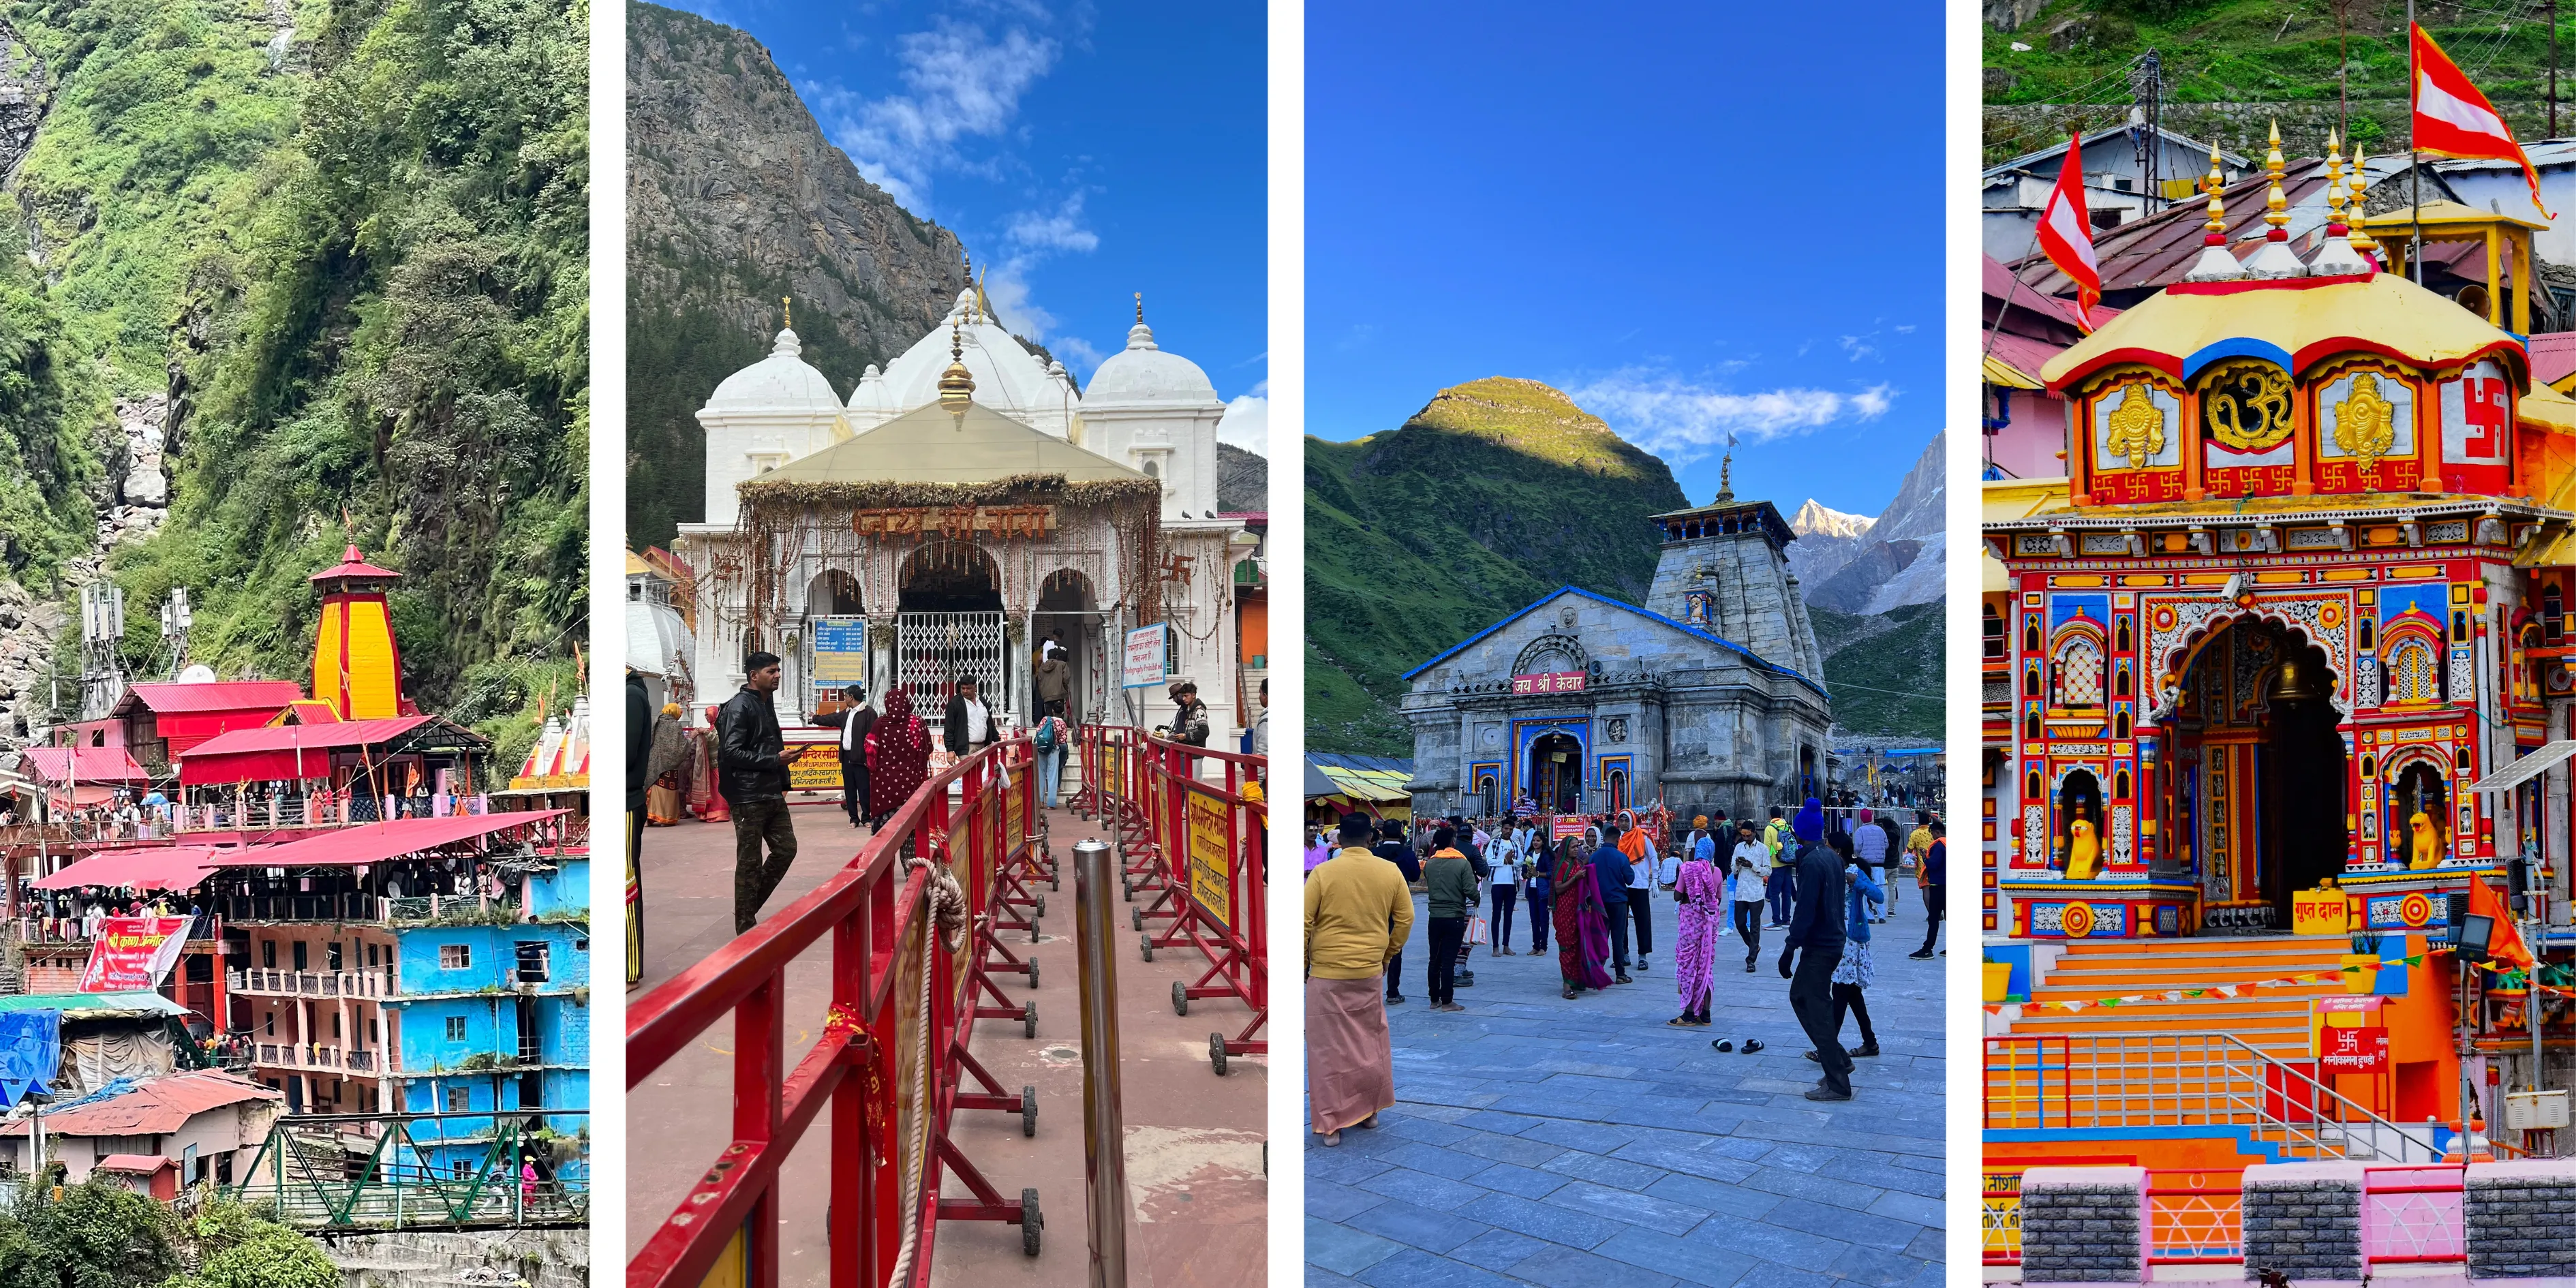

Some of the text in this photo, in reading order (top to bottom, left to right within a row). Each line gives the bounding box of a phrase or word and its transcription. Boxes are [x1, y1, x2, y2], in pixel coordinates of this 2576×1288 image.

[853, 506, 930, 542] जय
[1515, 672, 1583, 693] जय श्री केदार
[823, 747, 839, 760] समि
[2295, 902, 2344, 923] गुप्त दान
[108, 932, 119, 948] श्री
[119, 935, 140, 951] कृष्ण
[2322, 1052, 2358, 1066] मनोकामना
